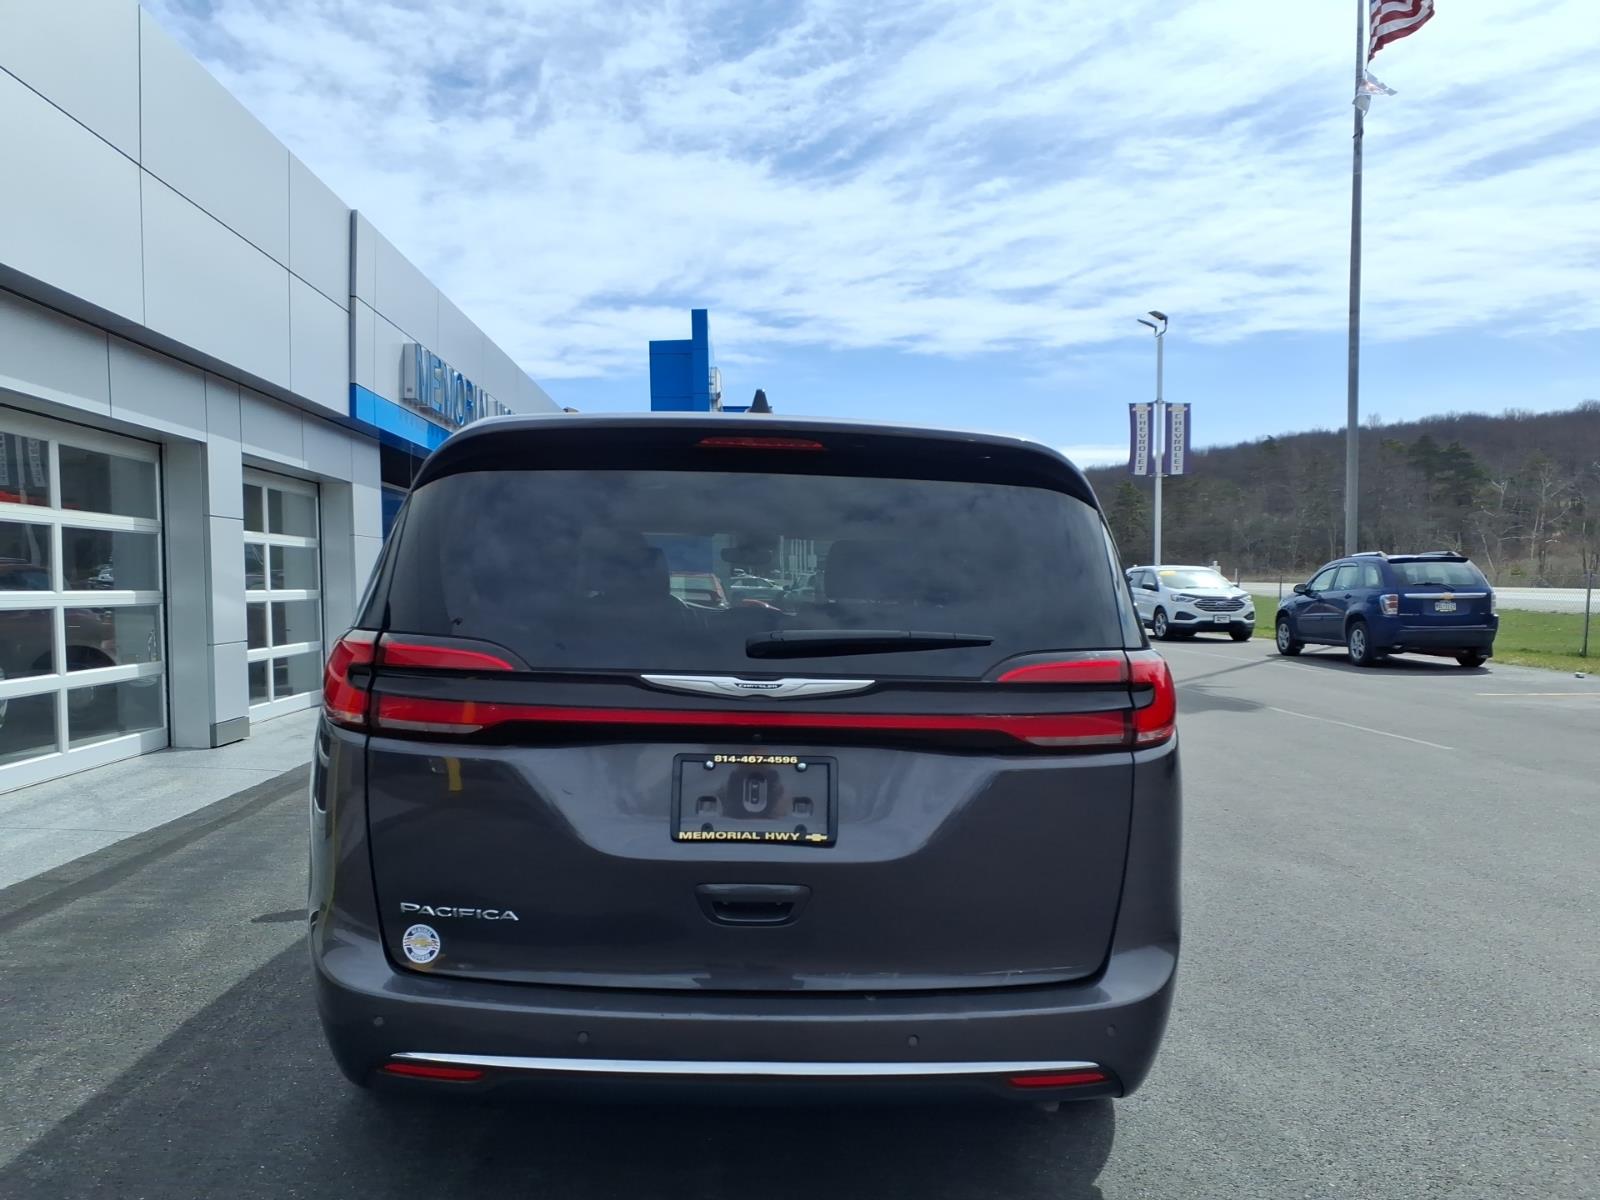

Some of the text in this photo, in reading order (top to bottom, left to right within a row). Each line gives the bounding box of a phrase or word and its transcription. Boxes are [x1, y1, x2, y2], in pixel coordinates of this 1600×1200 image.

[1137, 413, 1147, 471] CHEVROLET
[1173, 413, 1183, 471] CHEVROLET
[713, 755, 798, 764] 814-467-4596
[678, 831, 801, 841] MEMORIAL HWY
[400, 902, 520, 921] PACIFICA
